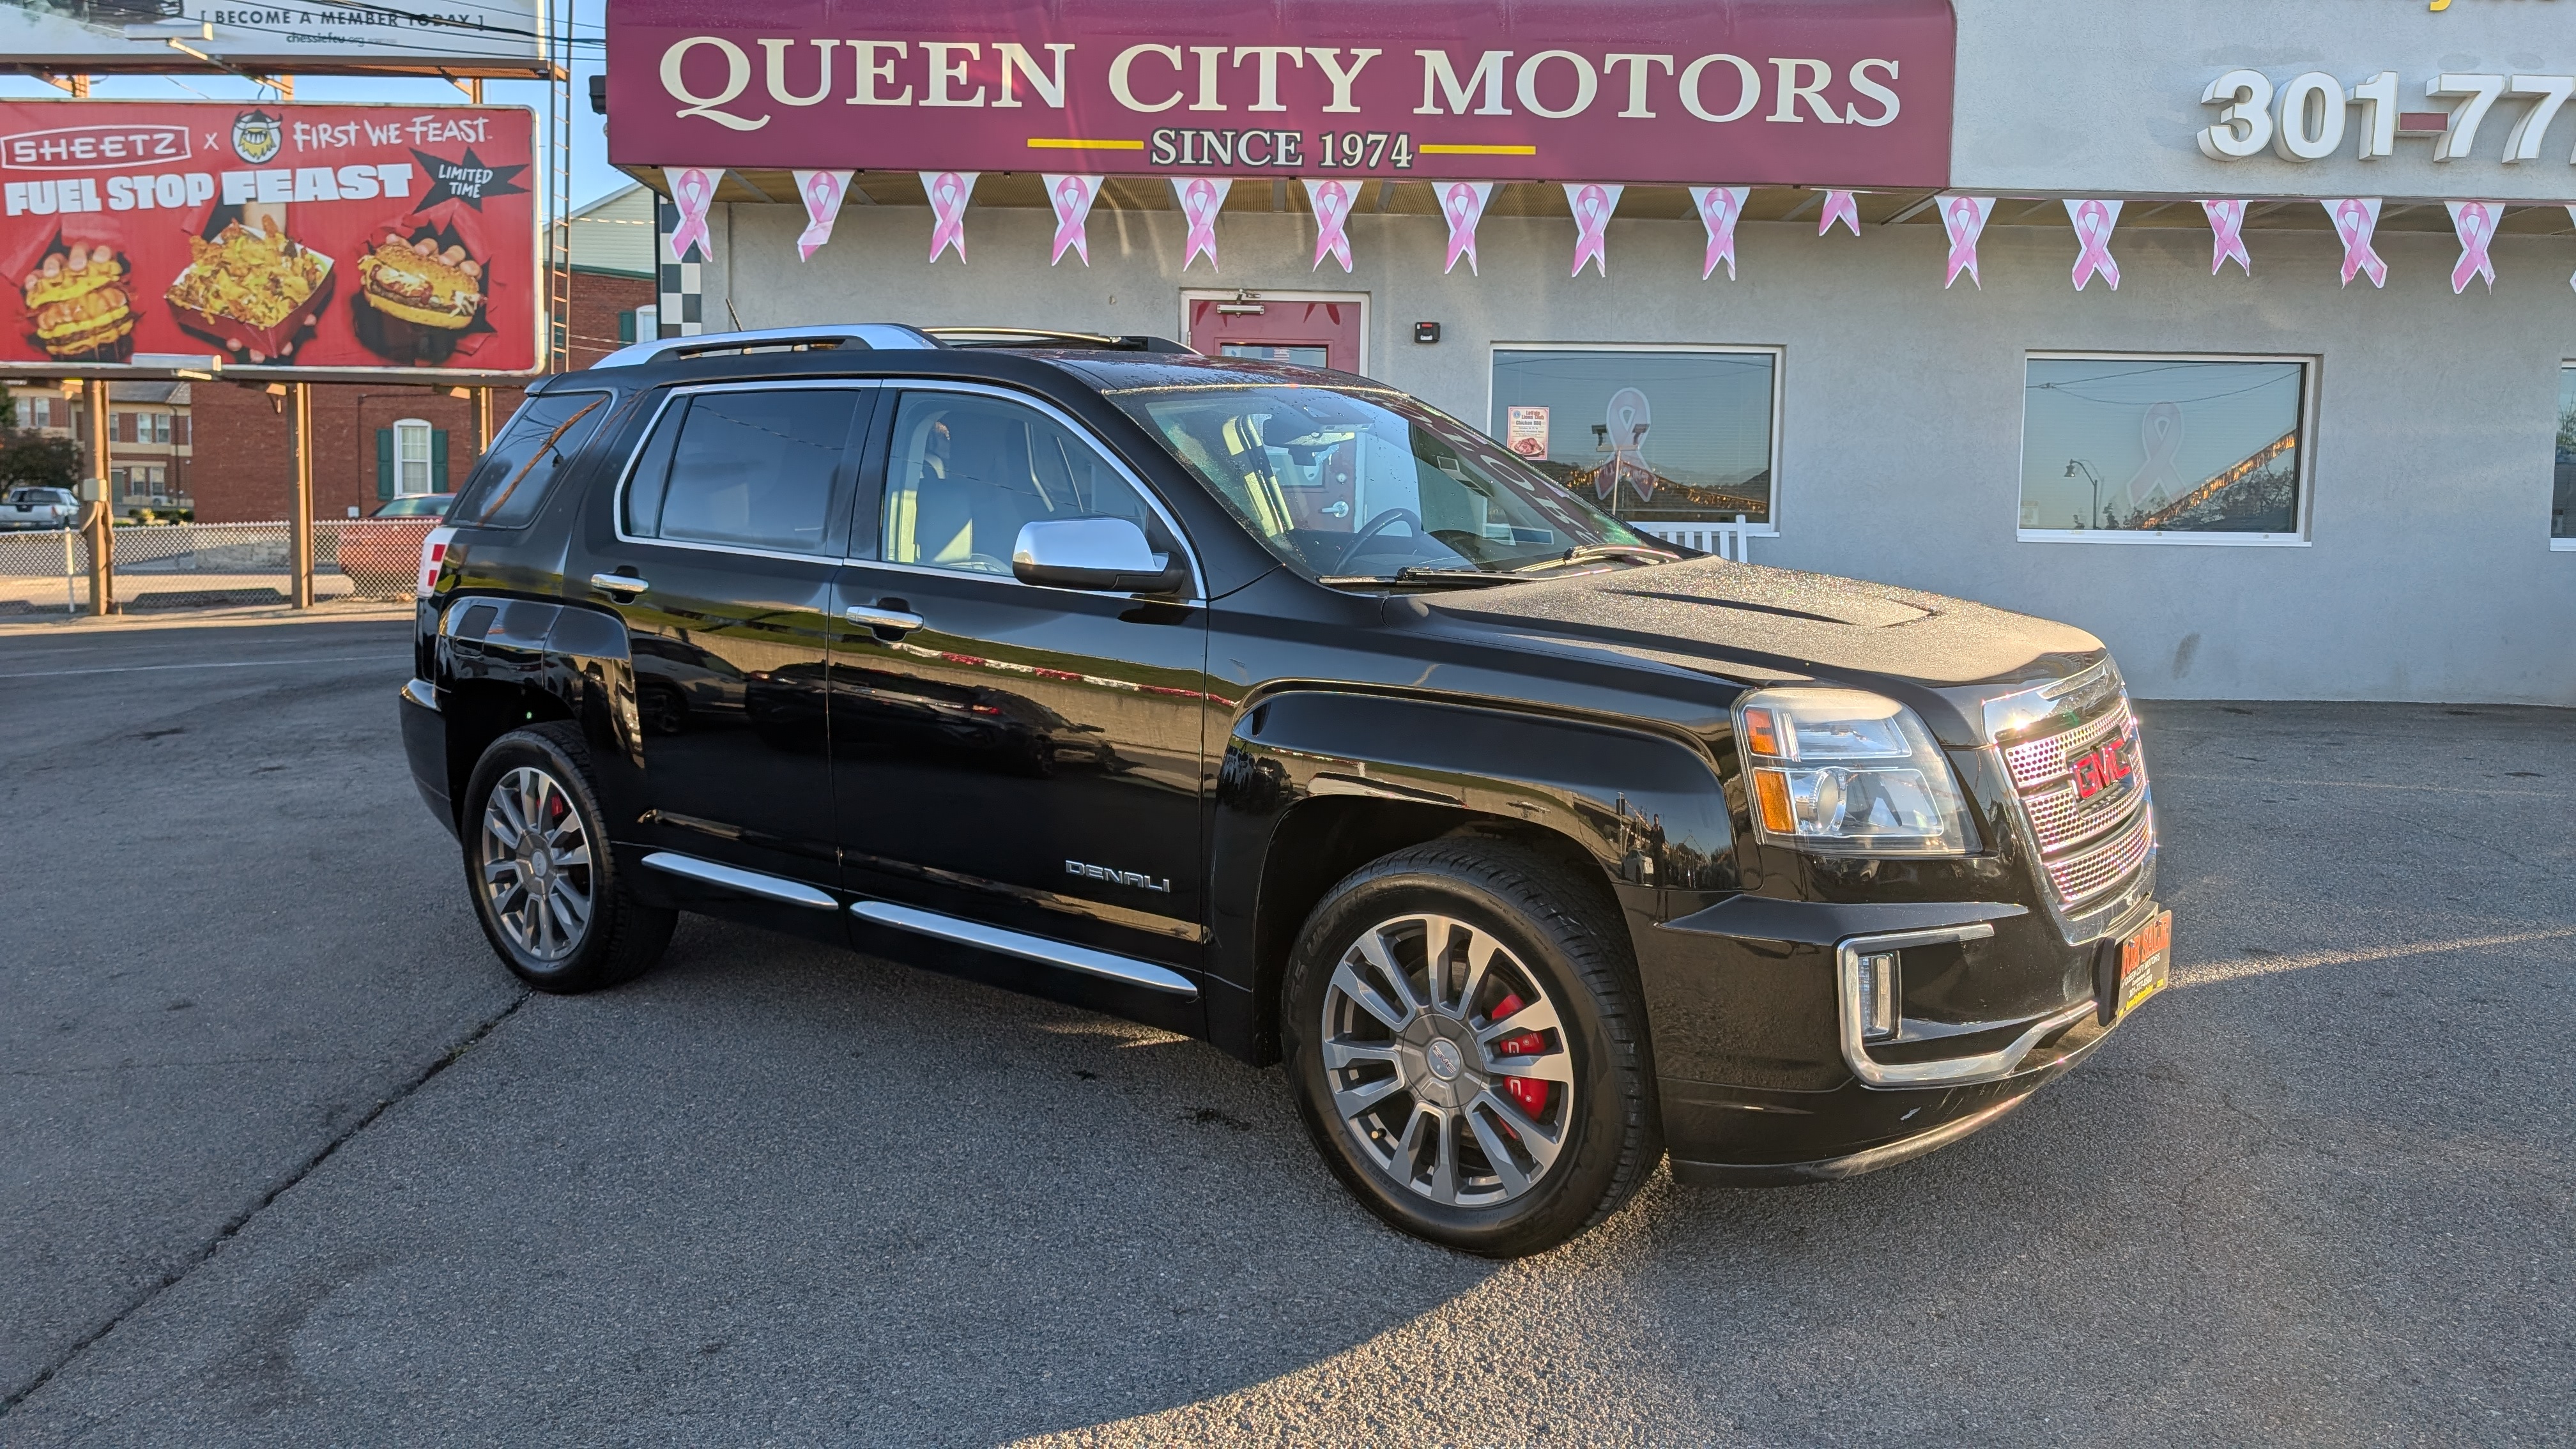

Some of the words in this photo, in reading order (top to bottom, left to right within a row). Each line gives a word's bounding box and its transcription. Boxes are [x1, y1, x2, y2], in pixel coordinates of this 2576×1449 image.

[215, 10, 291, 24] BECOME
[299, 12, 312, 24] A
[321, 12, 398, 26] MEMBER
[659, 36, 1075, 130] QUEEN
[1108, 44, 1383, 114] CITY
[1413, 50, 1901, 126] MOTORS
[13, 132, 176, 163] SHEETZ
[293, 119, 360, 153] FIRST
[364, 118, 403, 147] WE
[405, 114, 490, 145] FEAST
[2196, 68, 2576, 165] 301-77
[1151, 128, 1304, 167] SINCE
[1319, 130, 1415, 169] 1974
[4, 178, 102, 217] FUEL
[106, 172, 215, 211] STOP
[220, 163, 413, 206] FEAST
[438, 164, 493, 185] LIMITED
[448, 181, 482, 198] TIME
[2073, 737, 2131, 799] GMC
[1065, 859, 1170, 893] DENALI
[2121, 934, 2140, 980] FOR
[2141, 915, 2169, 963] SALE
[1432, 1045, 1457, 1074] GMC
